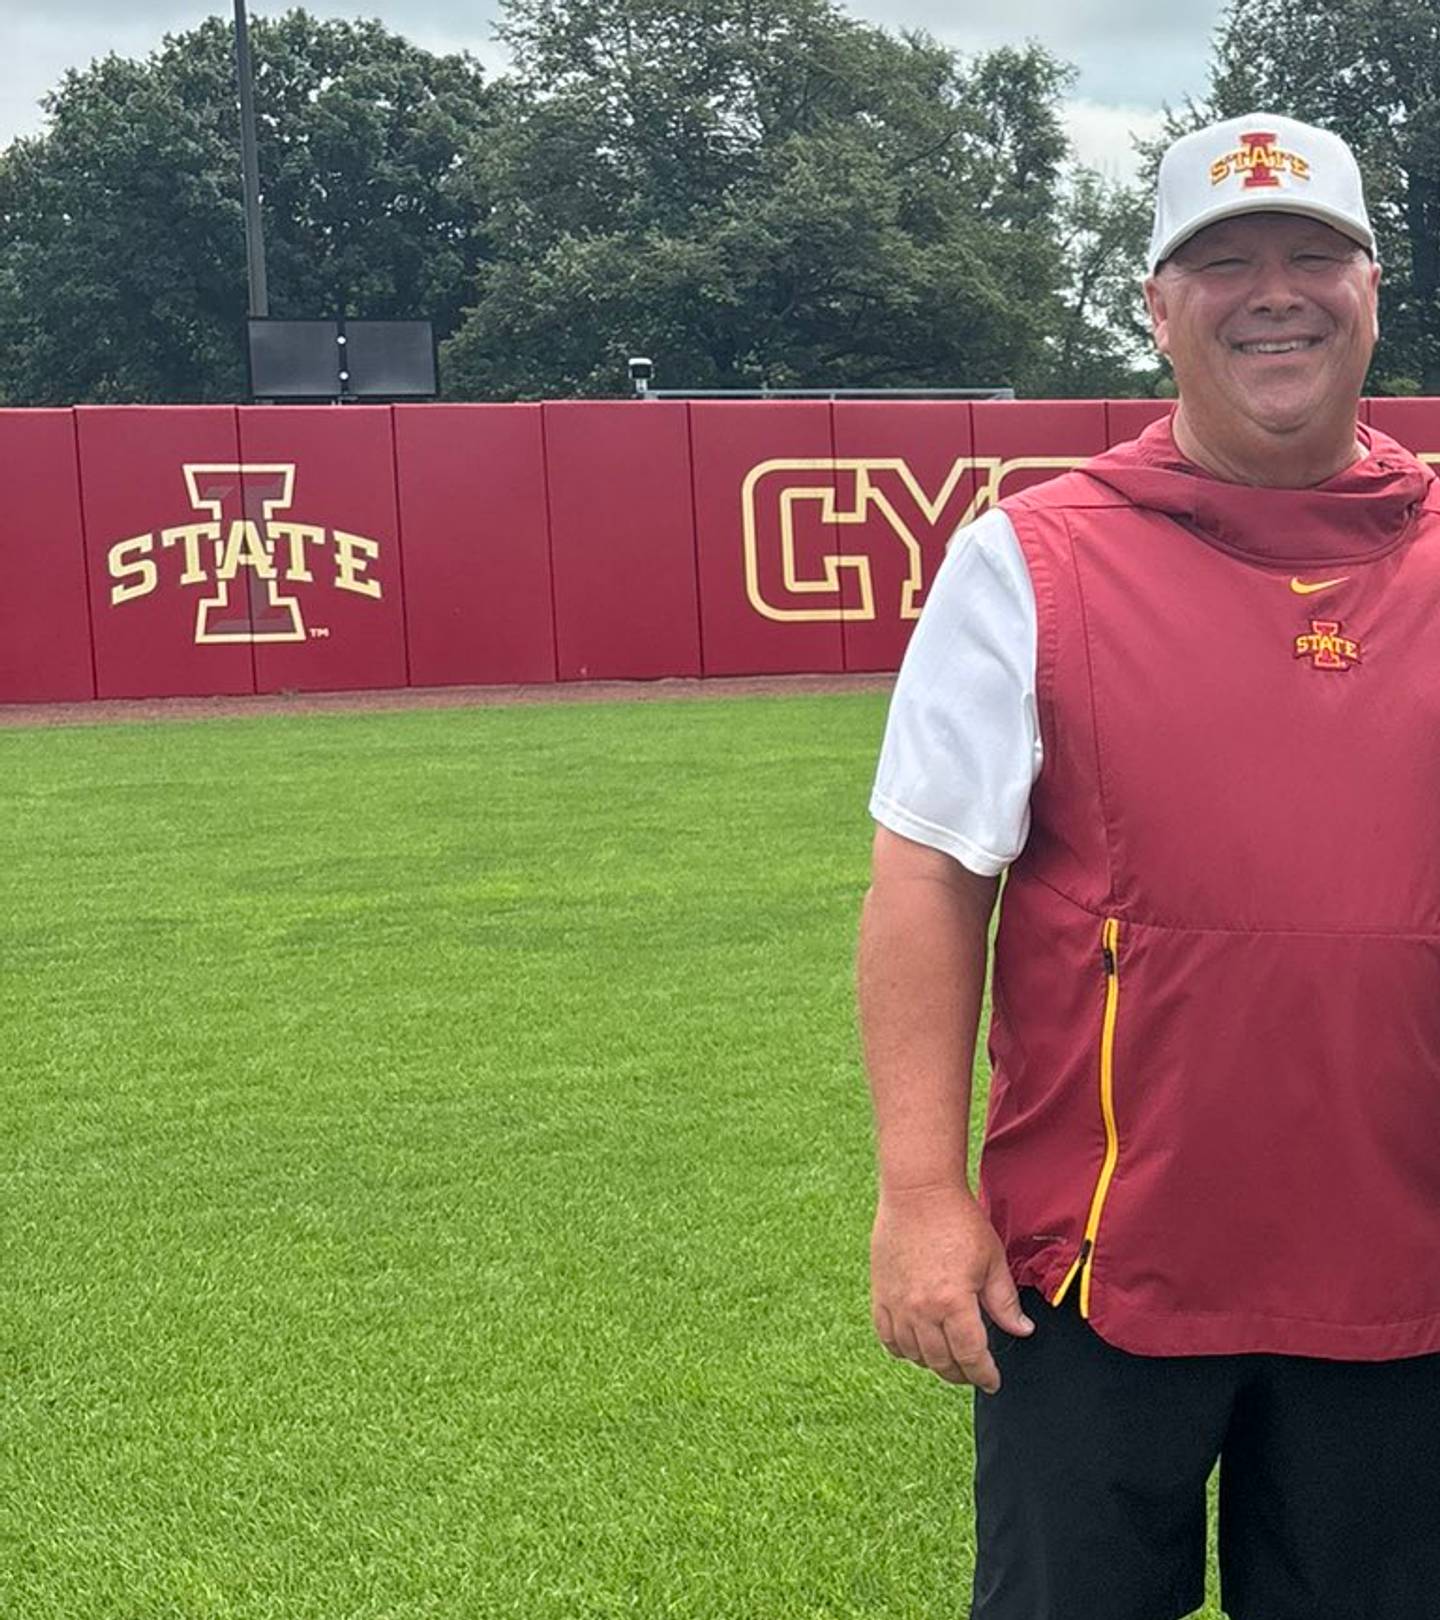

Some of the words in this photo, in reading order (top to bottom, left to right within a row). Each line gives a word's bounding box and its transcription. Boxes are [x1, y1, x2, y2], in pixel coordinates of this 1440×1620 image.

[1211, 147, 1310, 185] STATE
[108, 520, 382, 605] STATE
[1296, 635, 1358, 659] STATE
